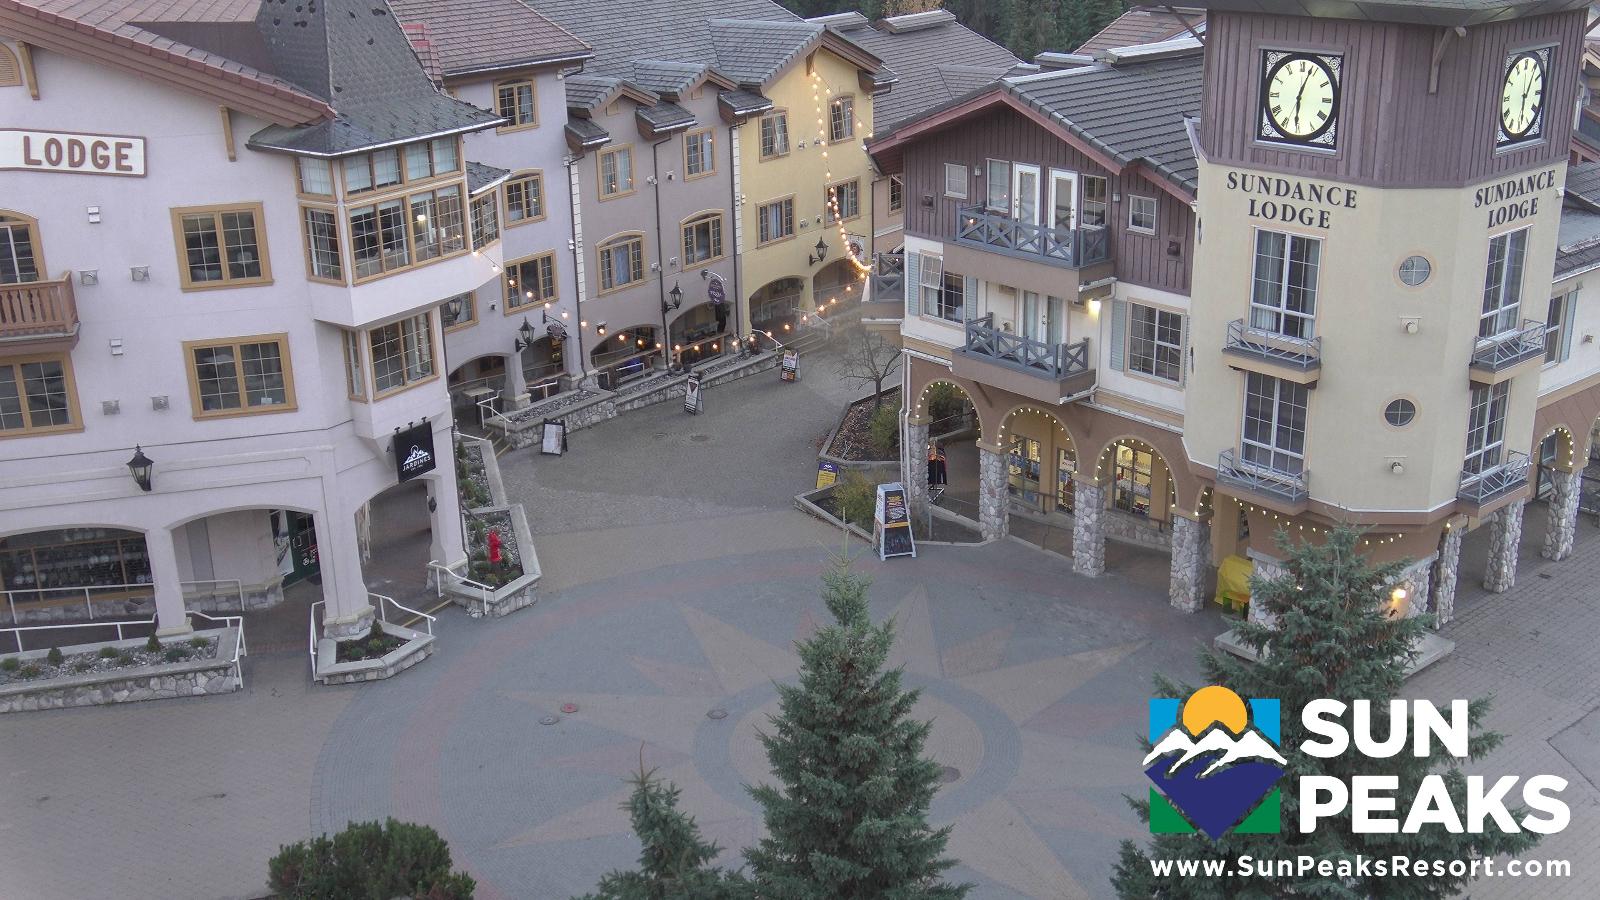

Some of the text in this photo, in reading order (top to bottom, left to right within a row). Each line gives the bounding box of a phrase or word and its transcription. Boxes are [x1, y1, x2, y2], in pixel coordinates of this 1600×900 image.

[23, 135, 133, 172] LODGE
[1226, 171, 1358, 209] SUNDANCE
[1474, 170, 1556, 208] SUNDANCE
[1247, 198, 1331, 229] LODGE
[1487, 197, 1539, 229] LODGE
[403, 455, 431, 471] JARDINES
